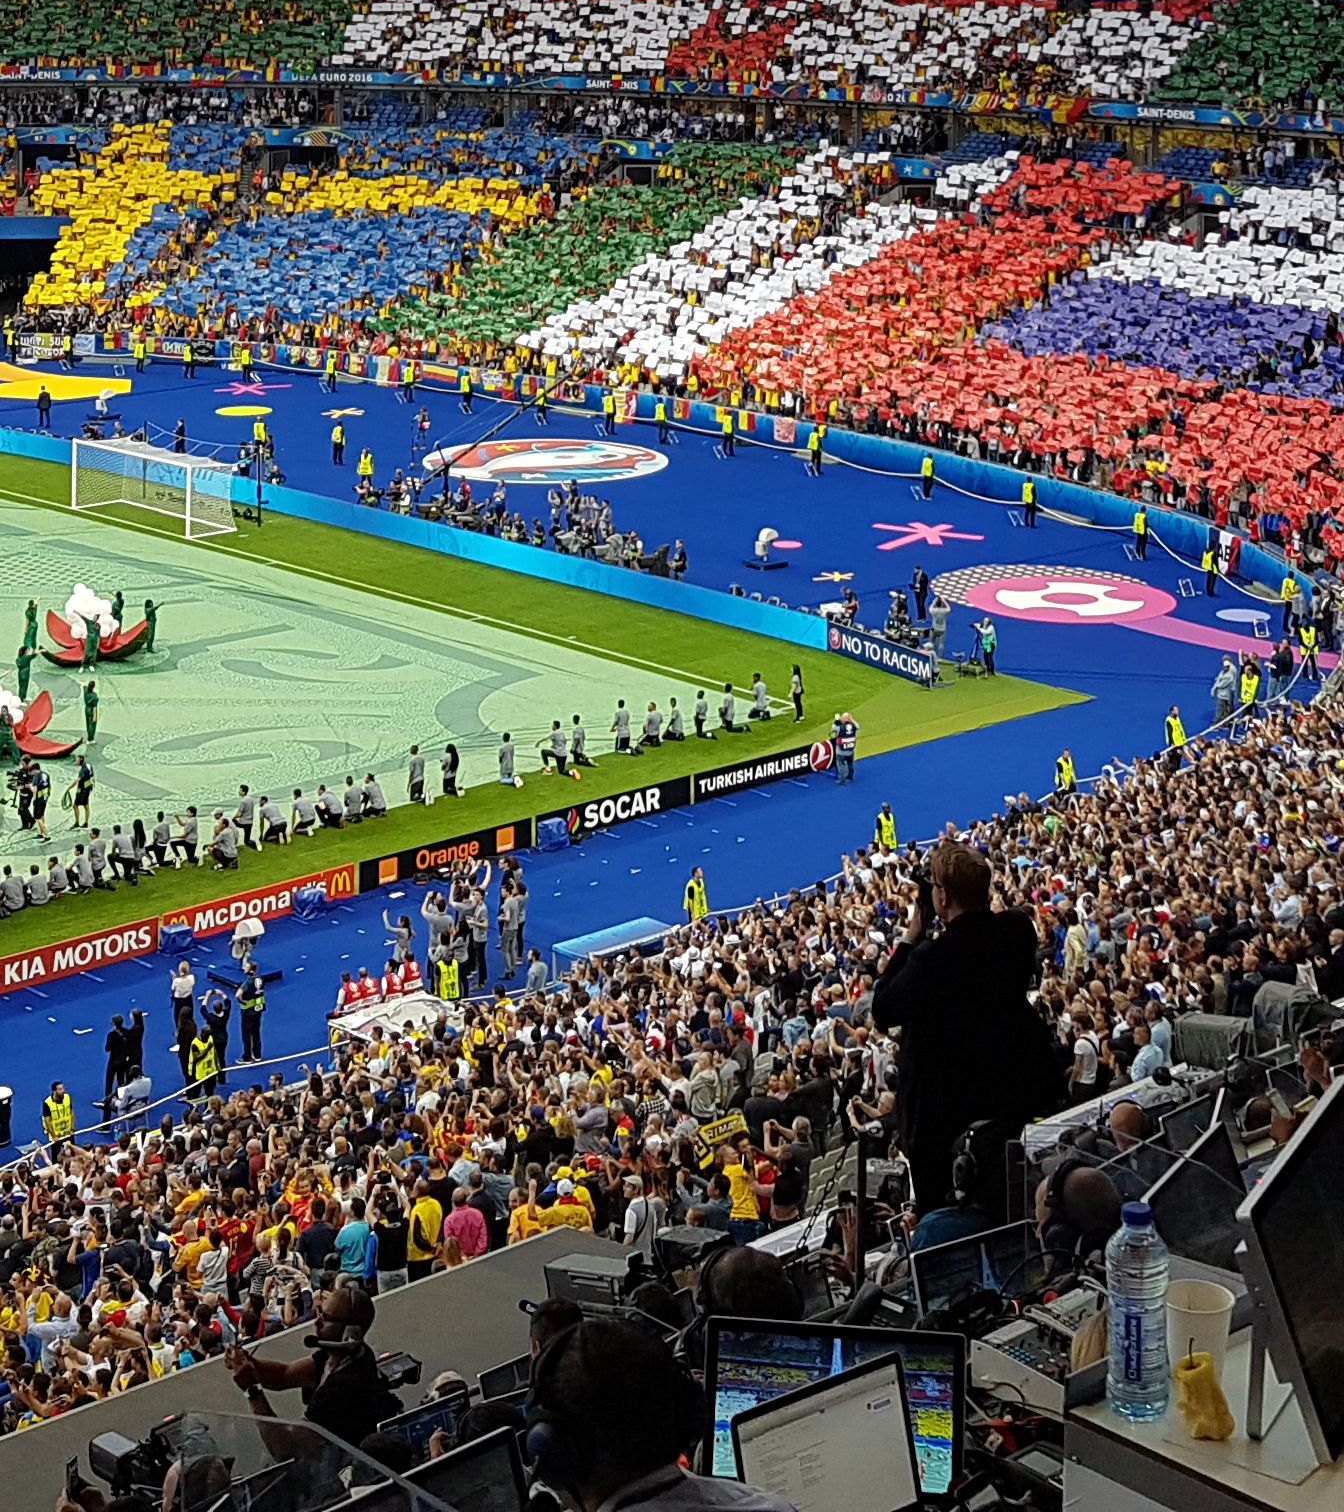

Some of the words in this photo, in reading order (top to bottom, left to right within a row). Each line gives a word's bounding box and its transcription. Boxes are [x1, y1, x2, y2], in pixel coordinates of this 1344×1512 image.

[320, 72, 347, 83] EURO
[348, 72, 373, 83] 2016
[1136, 106, 1196, 121] SAINT-DENIS
[841, 632, 862, 656] NO
[863, 641, 881, 662] TO
[882, 647, 931, 679] RACISM
[698, 767, 754, 795] TURKISH
[754, 752, 809, 780] AIRLINES
[584, 787, 661, 829] SOCAR
[415, 839, 480, 870] Orange
[4, 955, 46, 987] KIA
[52, 925, 152, 973] MOTORS
